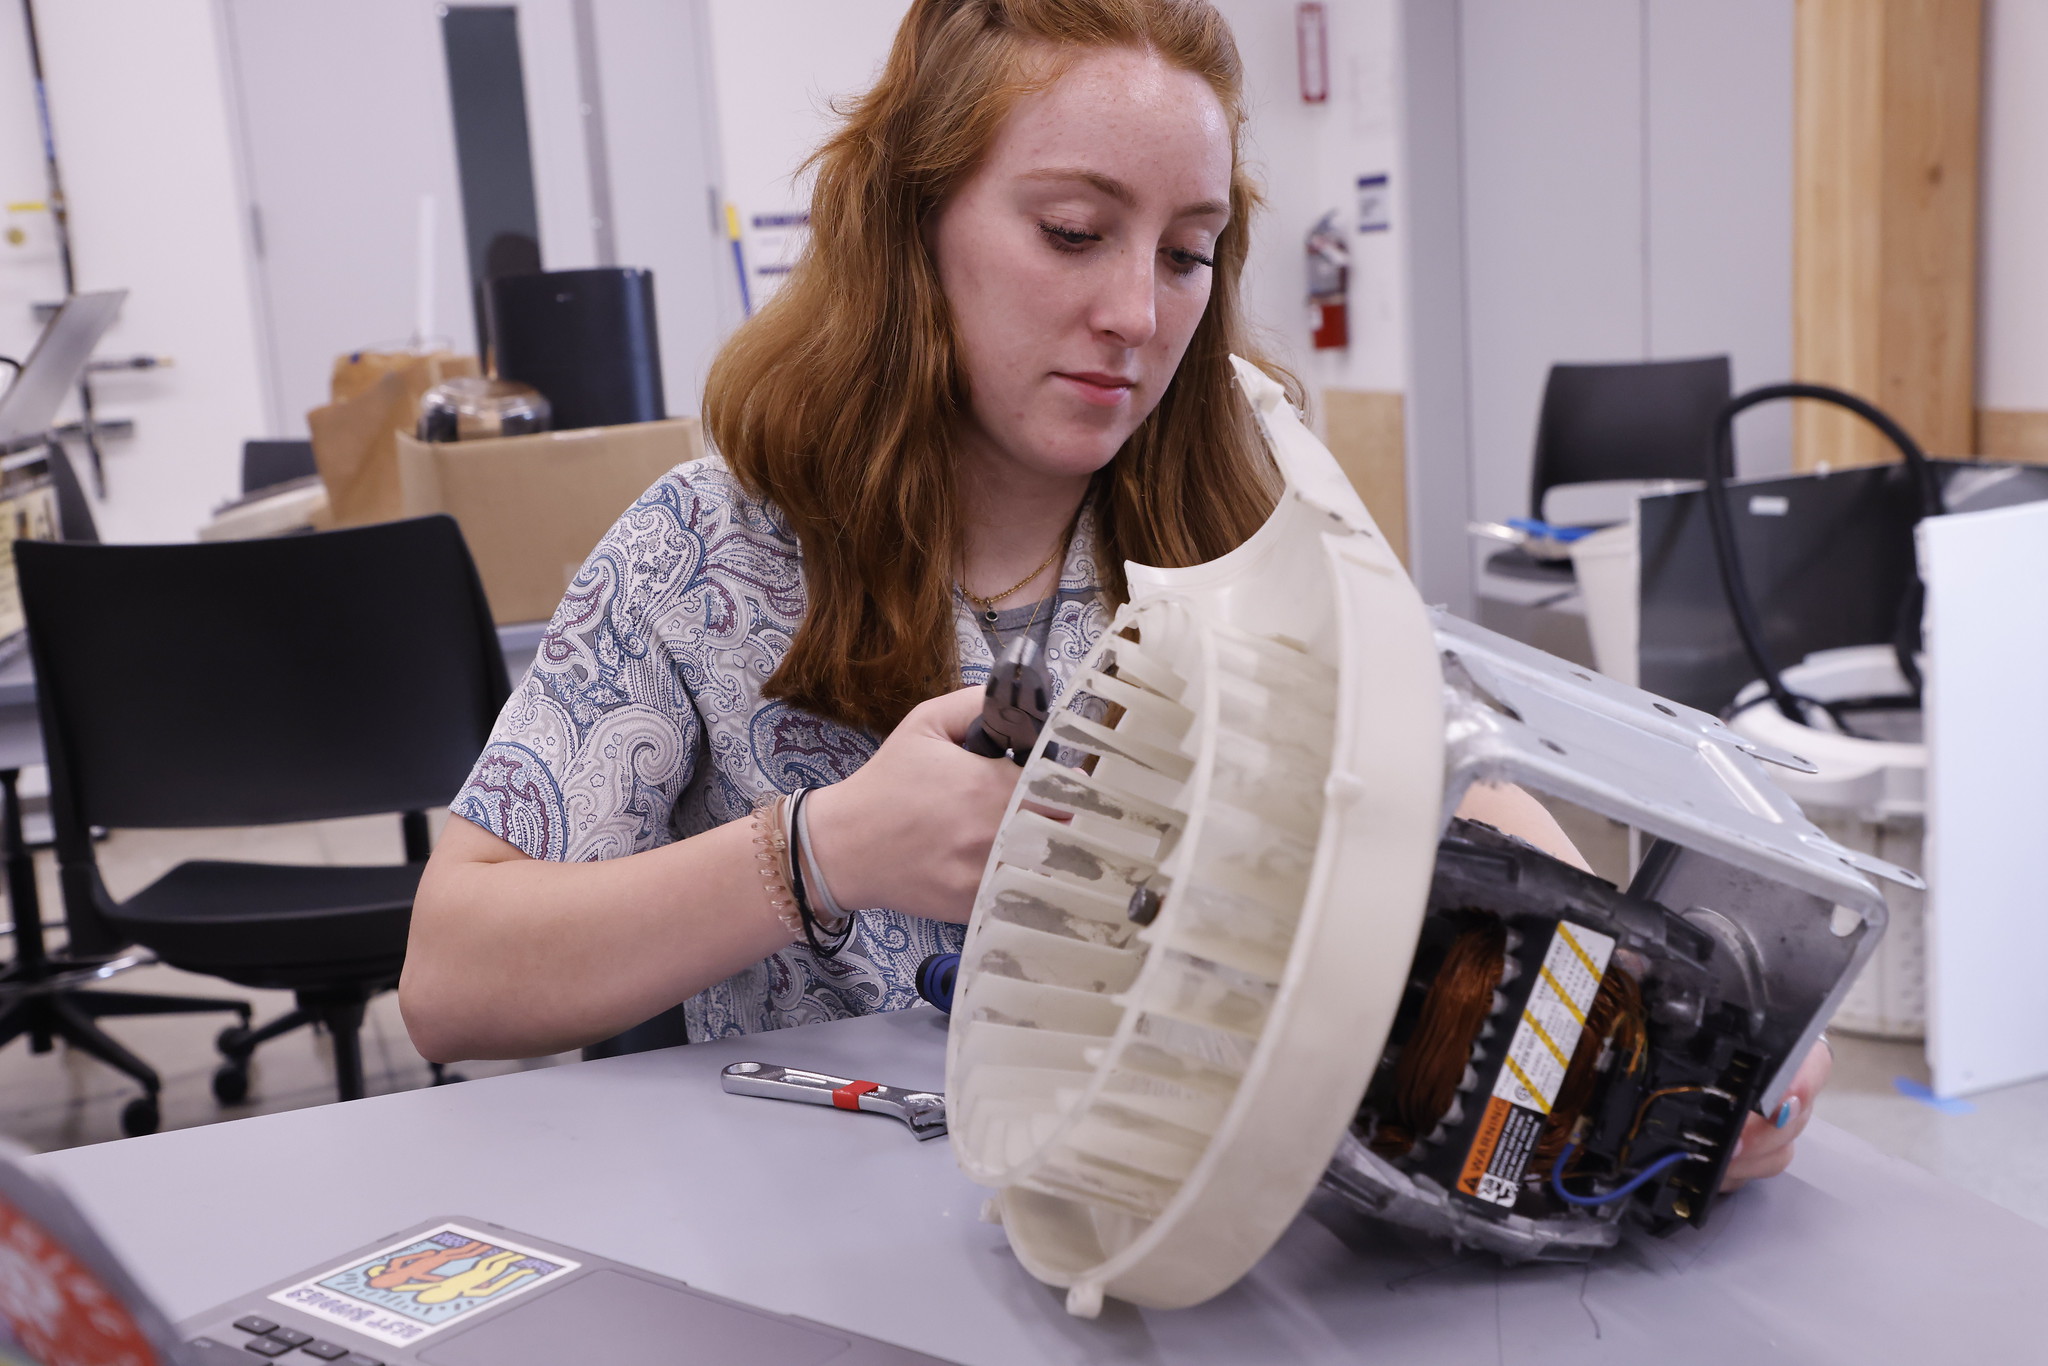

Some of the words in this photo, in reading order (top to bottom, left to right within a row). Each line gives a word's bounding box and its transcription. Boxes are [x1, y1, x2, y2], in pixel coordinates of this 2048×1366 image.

[1471, 1099, 1508, 1172] WARNING
[285, 1288, 375, 1322] BUDDIES
[368, 1316, 424, 1339] BEST
